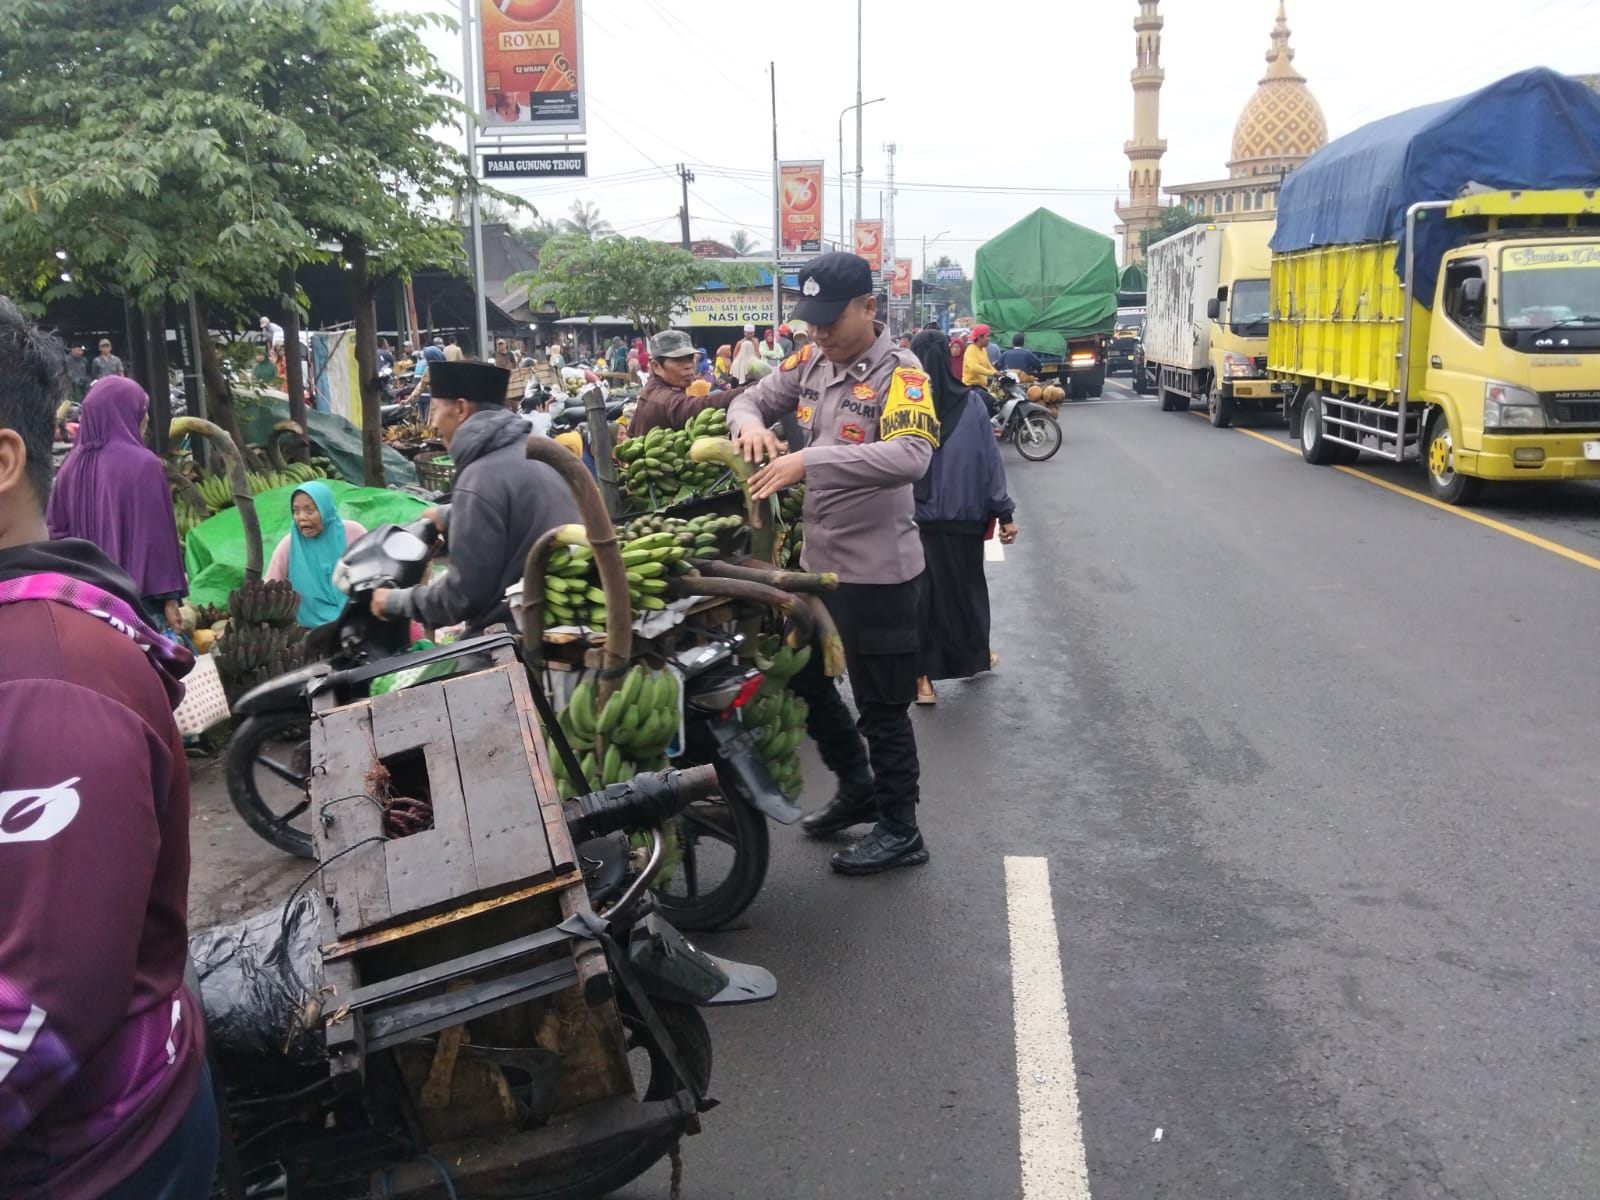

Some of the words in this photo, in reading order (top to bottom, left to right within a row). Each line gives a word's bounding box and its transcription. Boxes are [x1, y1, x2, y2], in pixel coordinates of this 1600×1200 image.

[502, 33, 556, 48] ROYAL
[488, 161, 515, 171] PASAR
[516, 160, 552, 171] GUNUNG
[552, 159, 581, 170] TENGU
[739, 304, 757, 312] AYAM
[708, 313, 738, 321] NASI
[841, 399, 875, 418] POLRI
